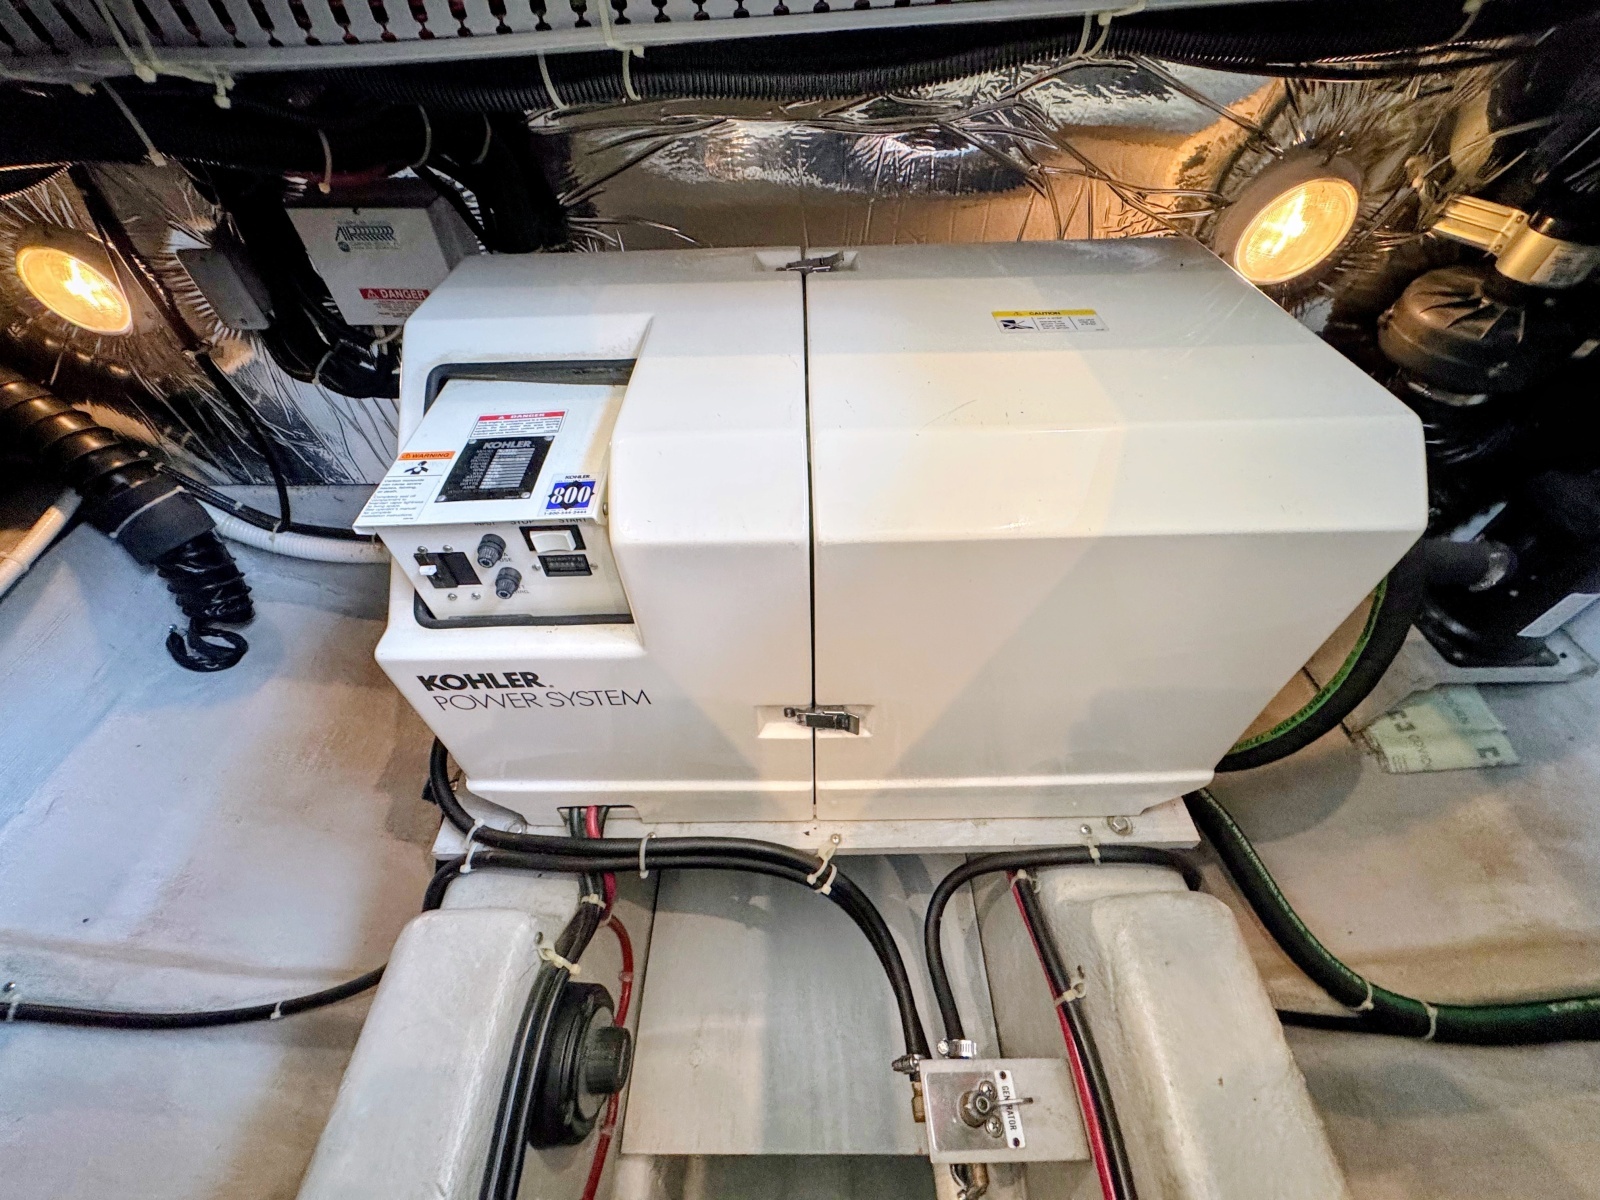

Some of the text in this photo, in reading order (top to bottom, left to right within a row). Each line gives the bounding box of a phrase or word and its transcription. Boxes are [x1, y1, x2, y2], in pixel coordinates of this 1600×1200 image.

[380, 289, 426, 299] DANGER
[482, 440, 532, 449] KOHLER
[550, 486, 591, 504] 800
[416, 671, 547, 692] KOHLER
[433, 689, 652, 711] POWER SYSTEM
[1001, 1085, 1017, 1131] GENRATOR
